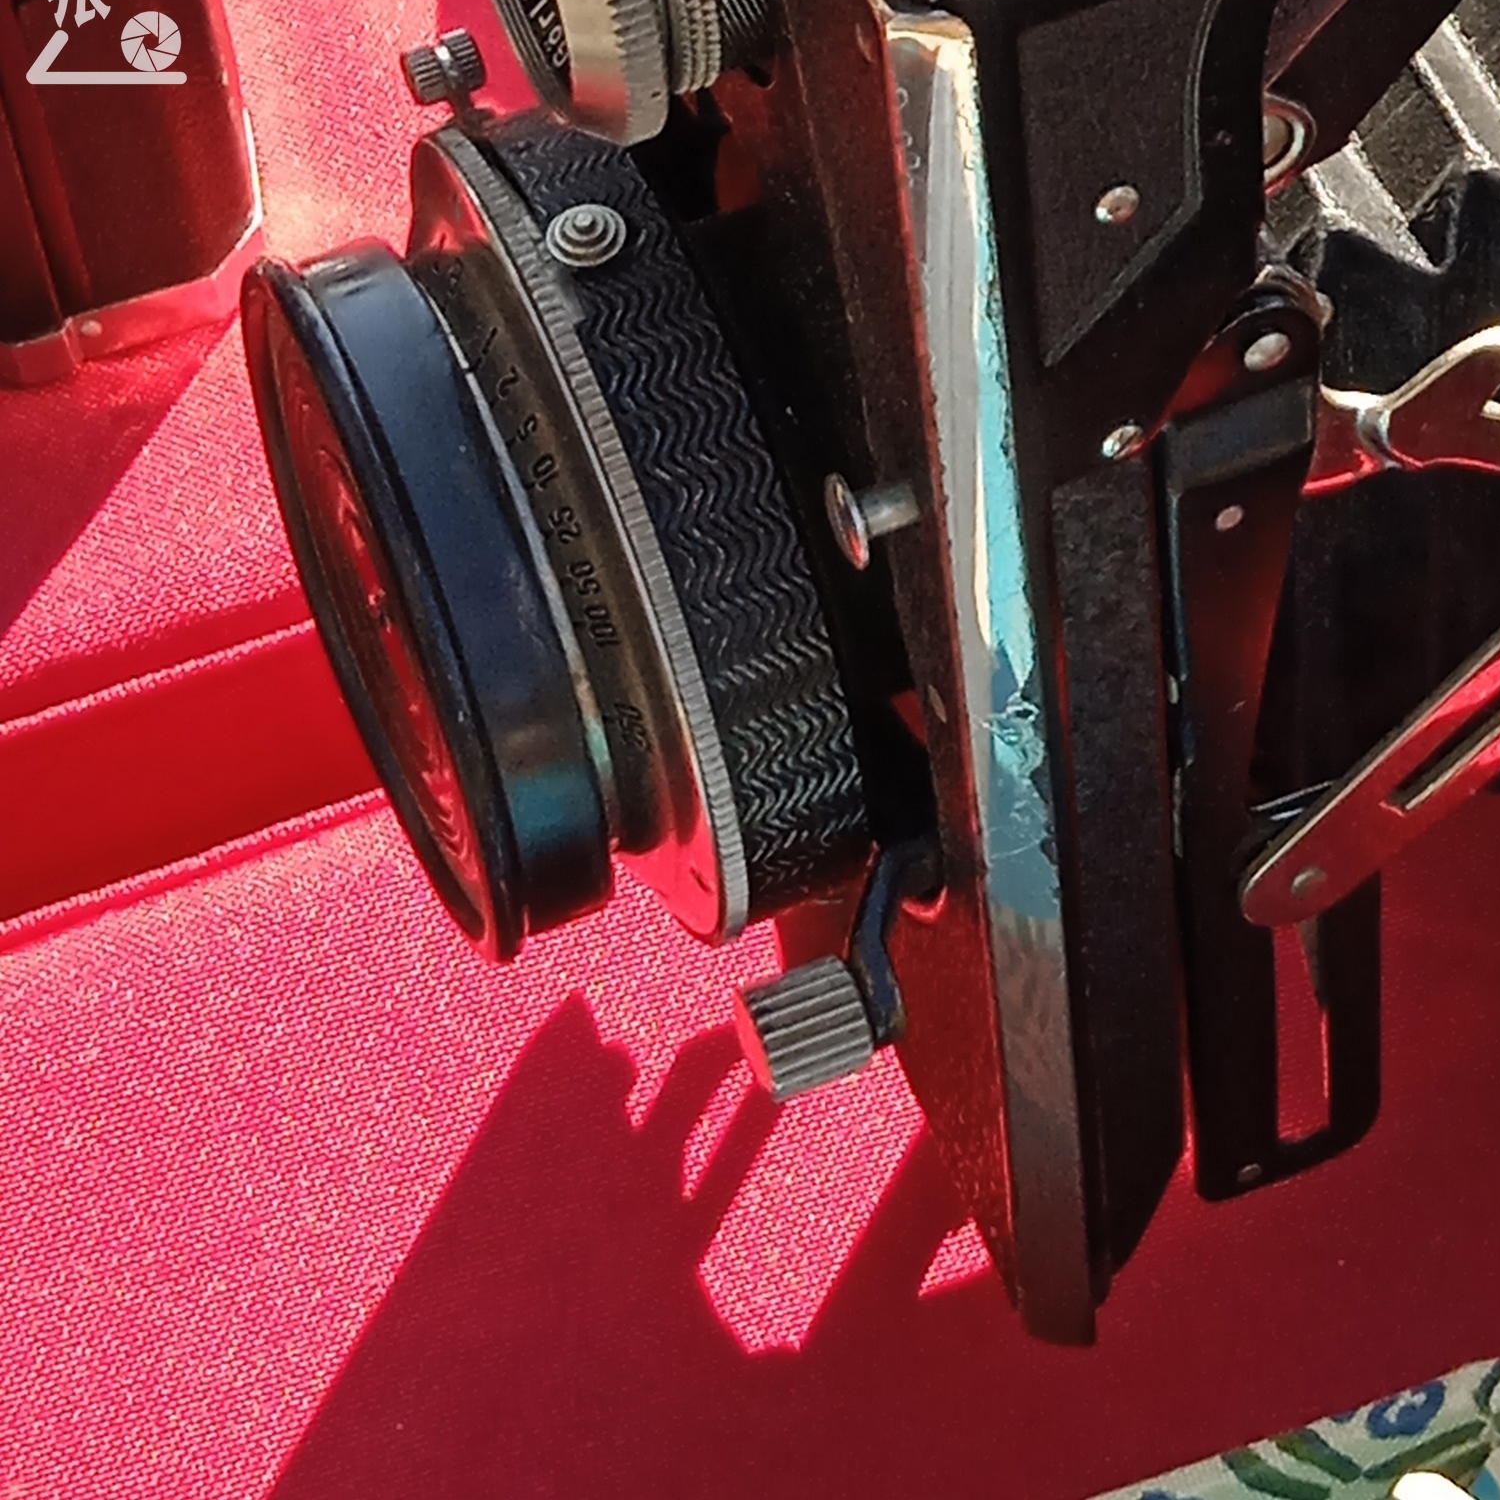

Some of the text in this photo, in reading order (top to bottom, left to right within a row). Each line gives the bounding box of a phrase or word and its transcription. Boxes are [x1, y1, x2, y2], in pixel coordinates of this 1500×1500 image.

[514, 411, 542, 442] 5
[530, 451, 562, 493] 10
[547, 504, 583, 546] 25
[568, 557, 602, 598] 50
[583, 603, 621, 648] 100
